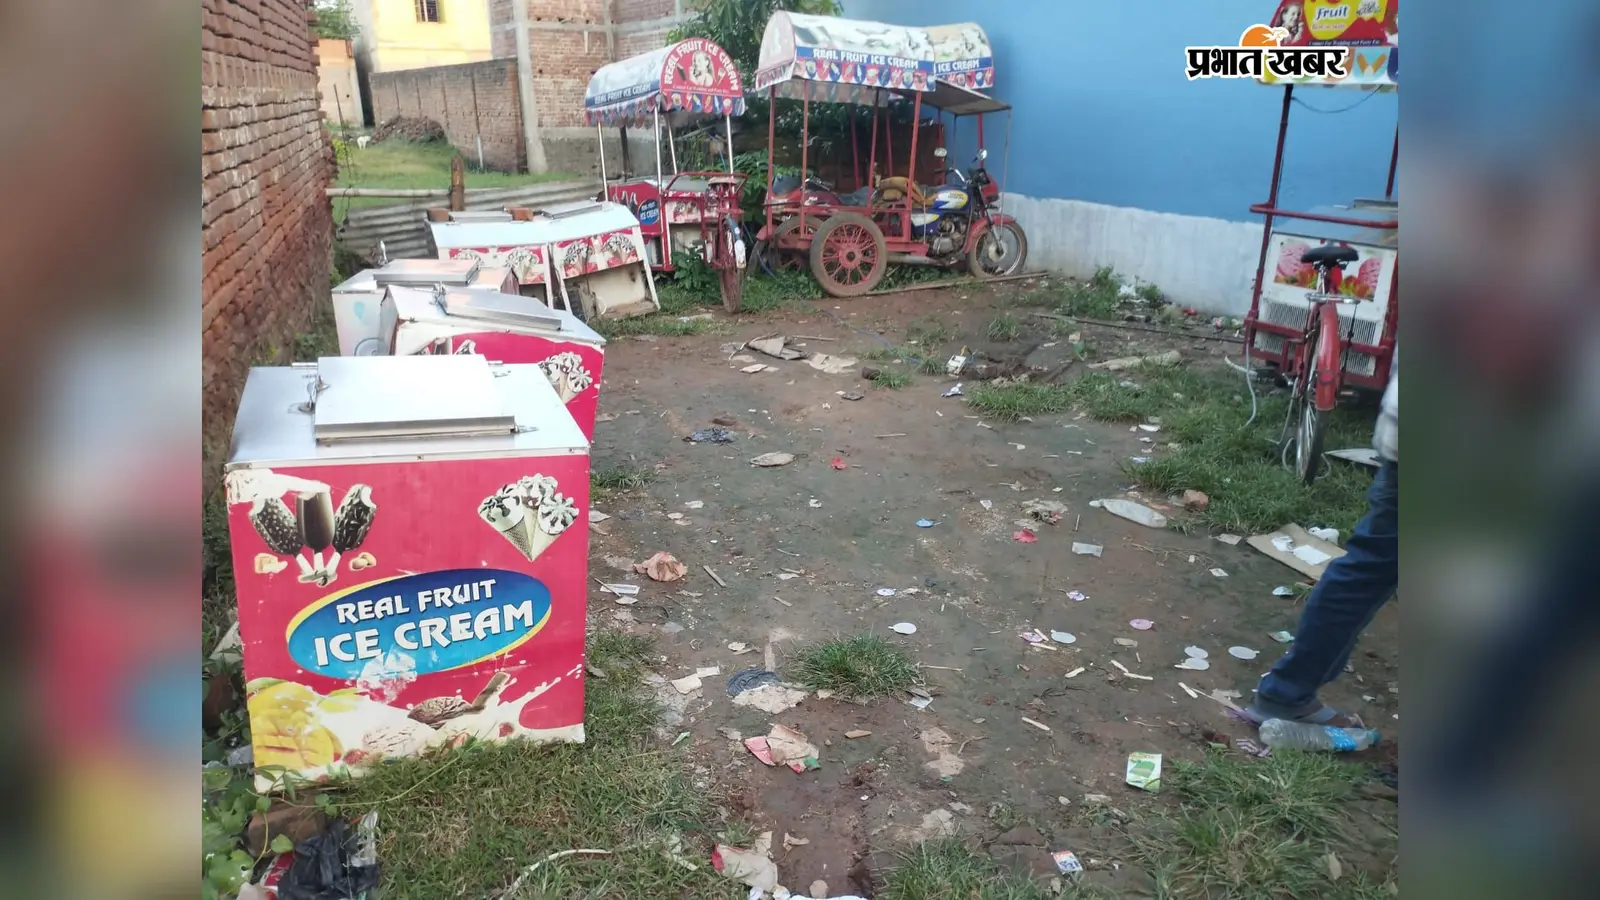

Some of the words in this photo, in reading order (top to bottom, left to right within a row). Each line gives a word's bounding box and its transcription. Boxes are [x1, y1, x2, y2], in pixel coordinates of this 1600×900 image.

[664, 55, 680, 84] REAL
[676, 40, 703, 57] FRUIT
[704, 42, 719, 56] ICE
[719, 52, 739, 91] CREAM
[813, 48, 838, 60] REAL
[841, 51, 868, 64] FRUIT
[871, 54, 885, 66] ICE
[888, 56, 918, 69] CREAM
[938, 61, 950, 72] ICE
[952, 59, 980, 70] CREAM
[623, 87, 631, 97] ICE
[632, 83, 651, 95] CREAM
[336, 595, 410, 625] REAL
[417, 578, 497, 613] FRUIT
[314, 629, 383, 667] ICE
[393, 600, 535, 650] CREAM
